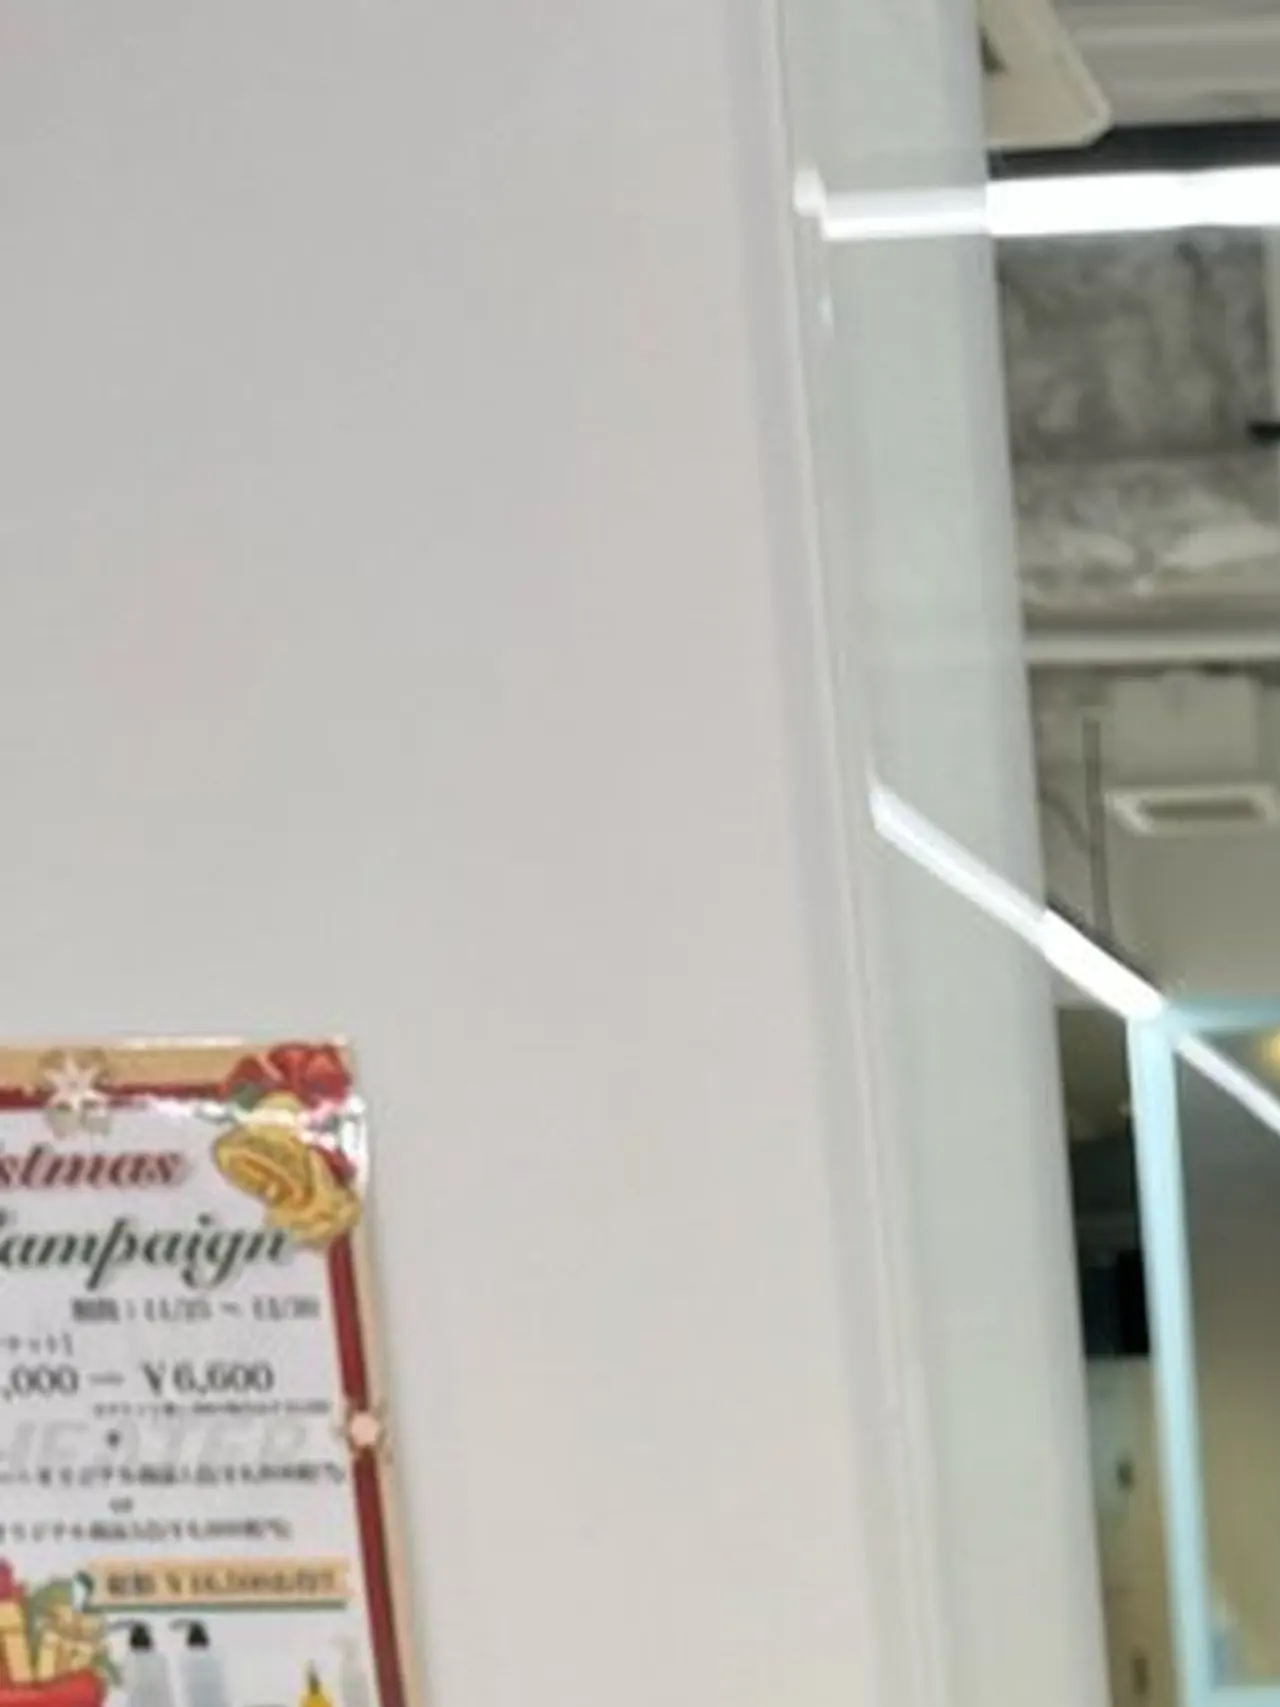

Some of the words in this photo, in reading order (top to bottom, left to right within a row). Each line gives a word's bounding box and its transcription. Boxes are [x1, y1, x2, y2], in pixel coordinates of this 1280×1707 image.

[0, 1208, 287, 1291] ampaign
[0, 1361, 80, 1405] ,000
[141, 1358, 275, 1398] ¥6,600
